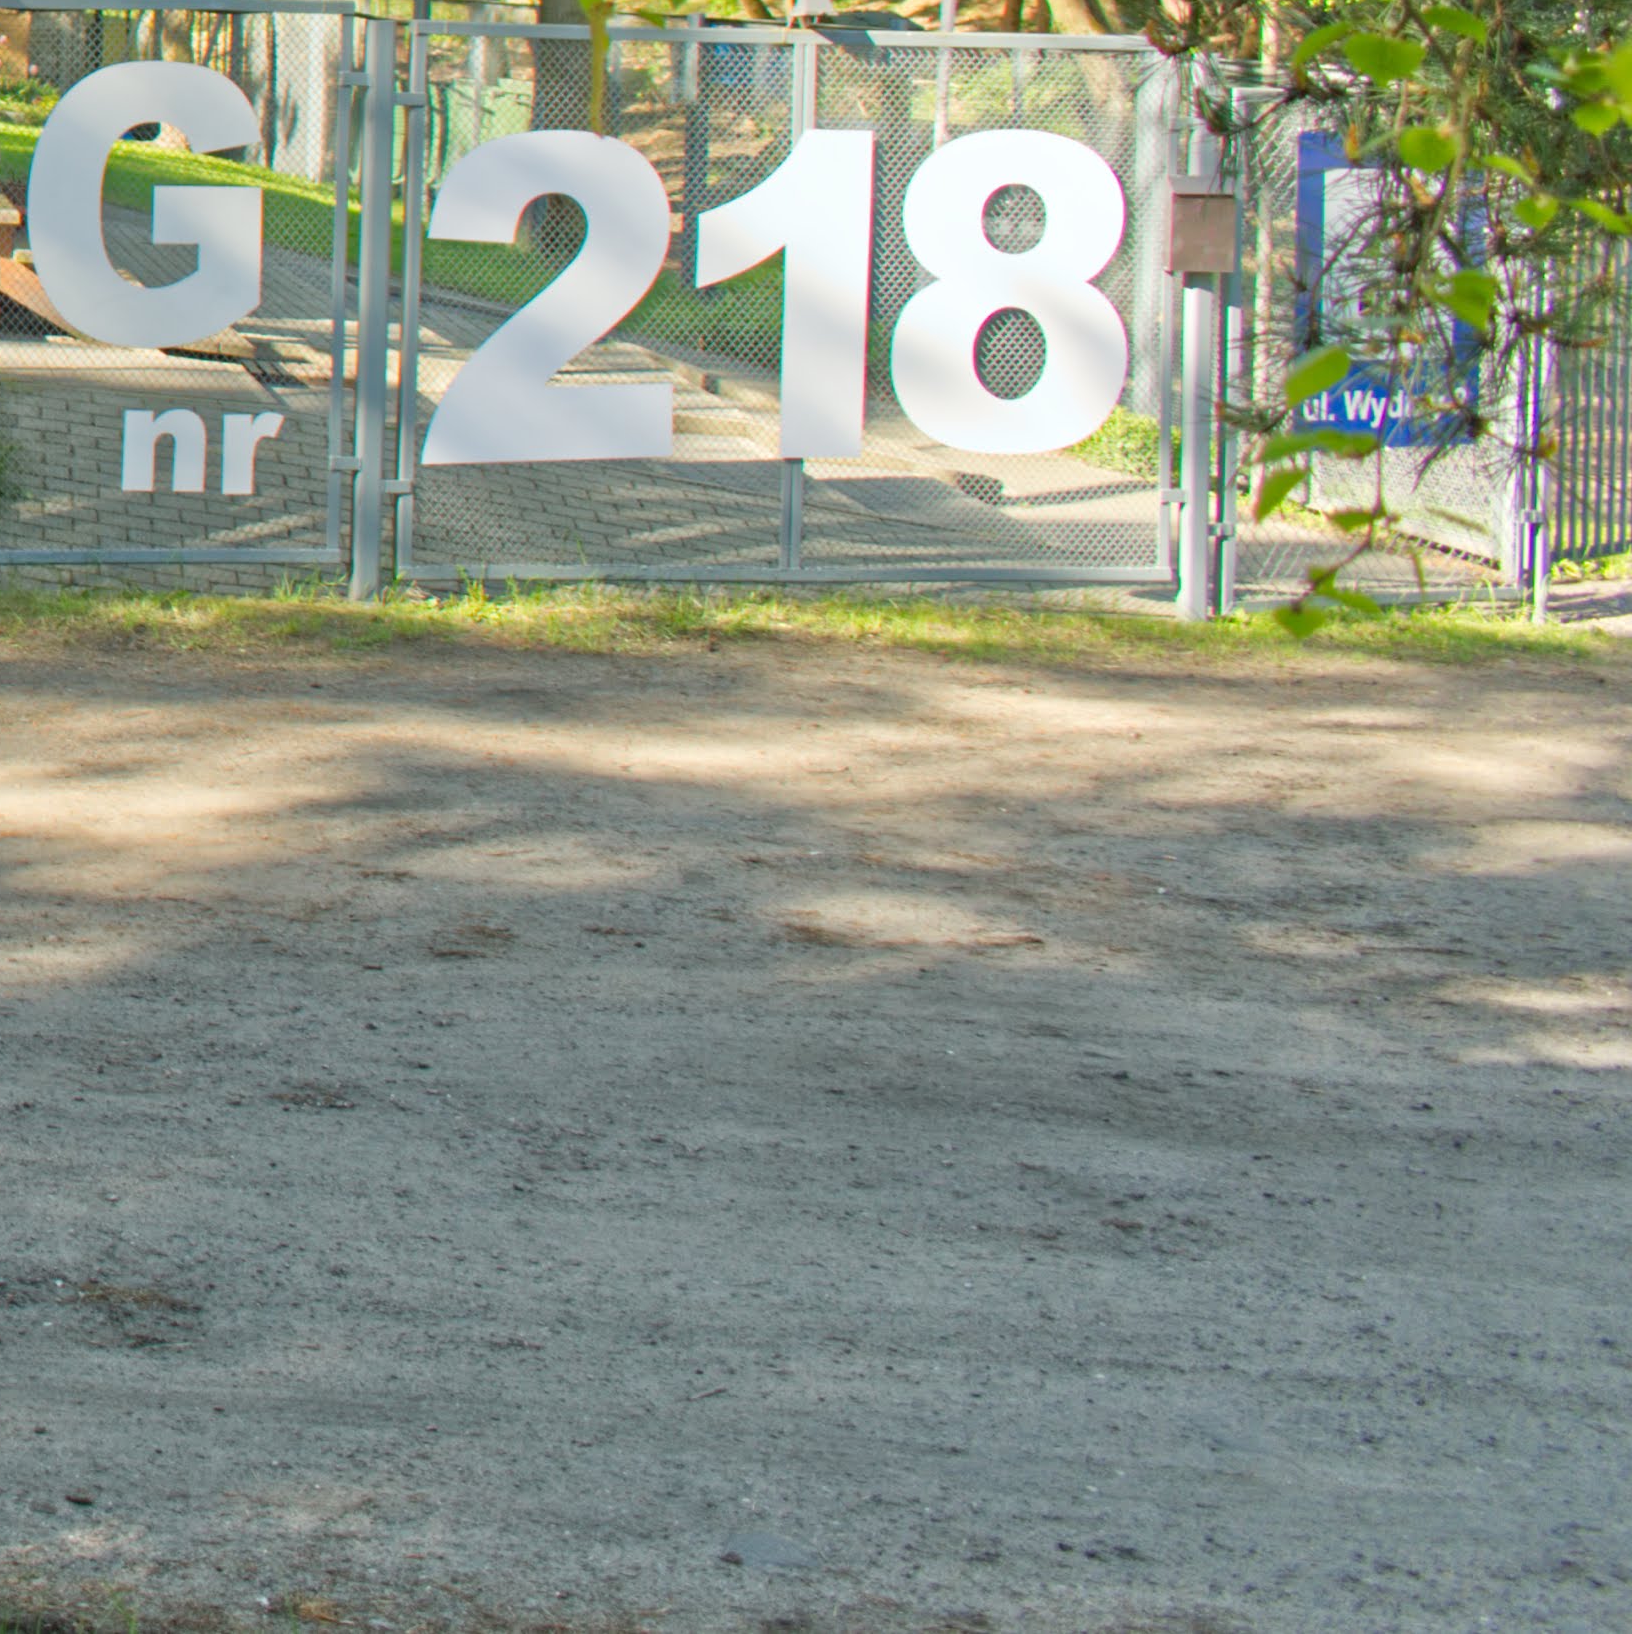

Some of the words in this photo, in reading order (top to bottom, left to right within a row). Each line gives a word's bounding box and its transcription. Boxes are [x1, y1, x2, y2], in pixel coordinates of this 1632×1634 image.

[421, 128, 1130, 465] 218
[1302, 391, 1336, 422] ul.
[121, 409, 284, 495] nr
